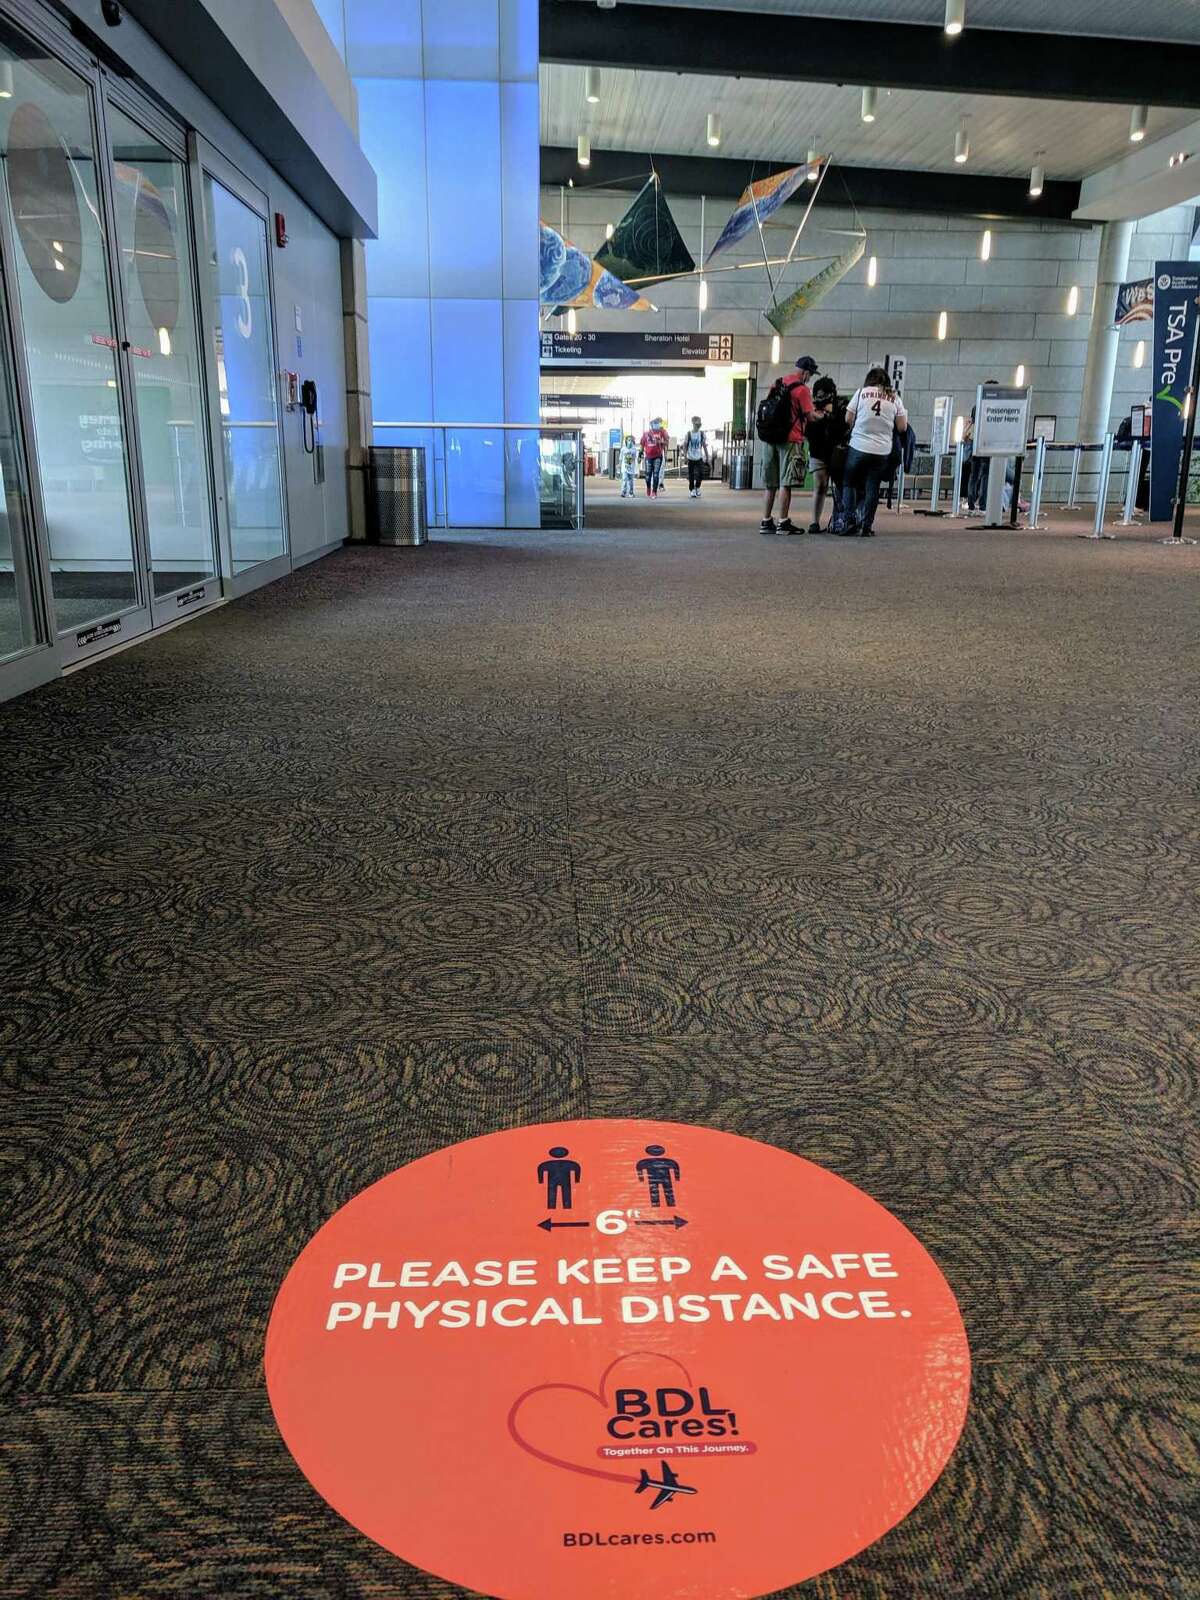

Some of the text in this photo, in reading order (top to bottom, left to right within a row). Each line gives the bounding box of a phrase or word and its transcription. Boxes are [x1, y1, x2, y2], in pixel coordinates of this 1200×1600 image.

[1166, 300, 1188, 344] TSA
[644, 334, 673, 342] Sheraton
[554, 346, 582, 355] Ticketing
[681, 347, 708, 355] Elevator
[1161, 349, 1182, 385] Pre
[871, 400, 881, 416] 4
[986, 407, 1021, 415] Passengers
[986, 415, 1020, 423] Enter Here
[332, 1252, 899, 1289] PLEASE KEEP A SAFE
[325, 1290, 912, 1331] PHYSICAL DISTANCE.
[615, 1386, 731, 1417] BDL
[606, 1412, 739, 1439] Cares!
[602, 1443, 749, 1457] Together On This Journey.
[563, 1531, 717, 1547] BDLcares.com
